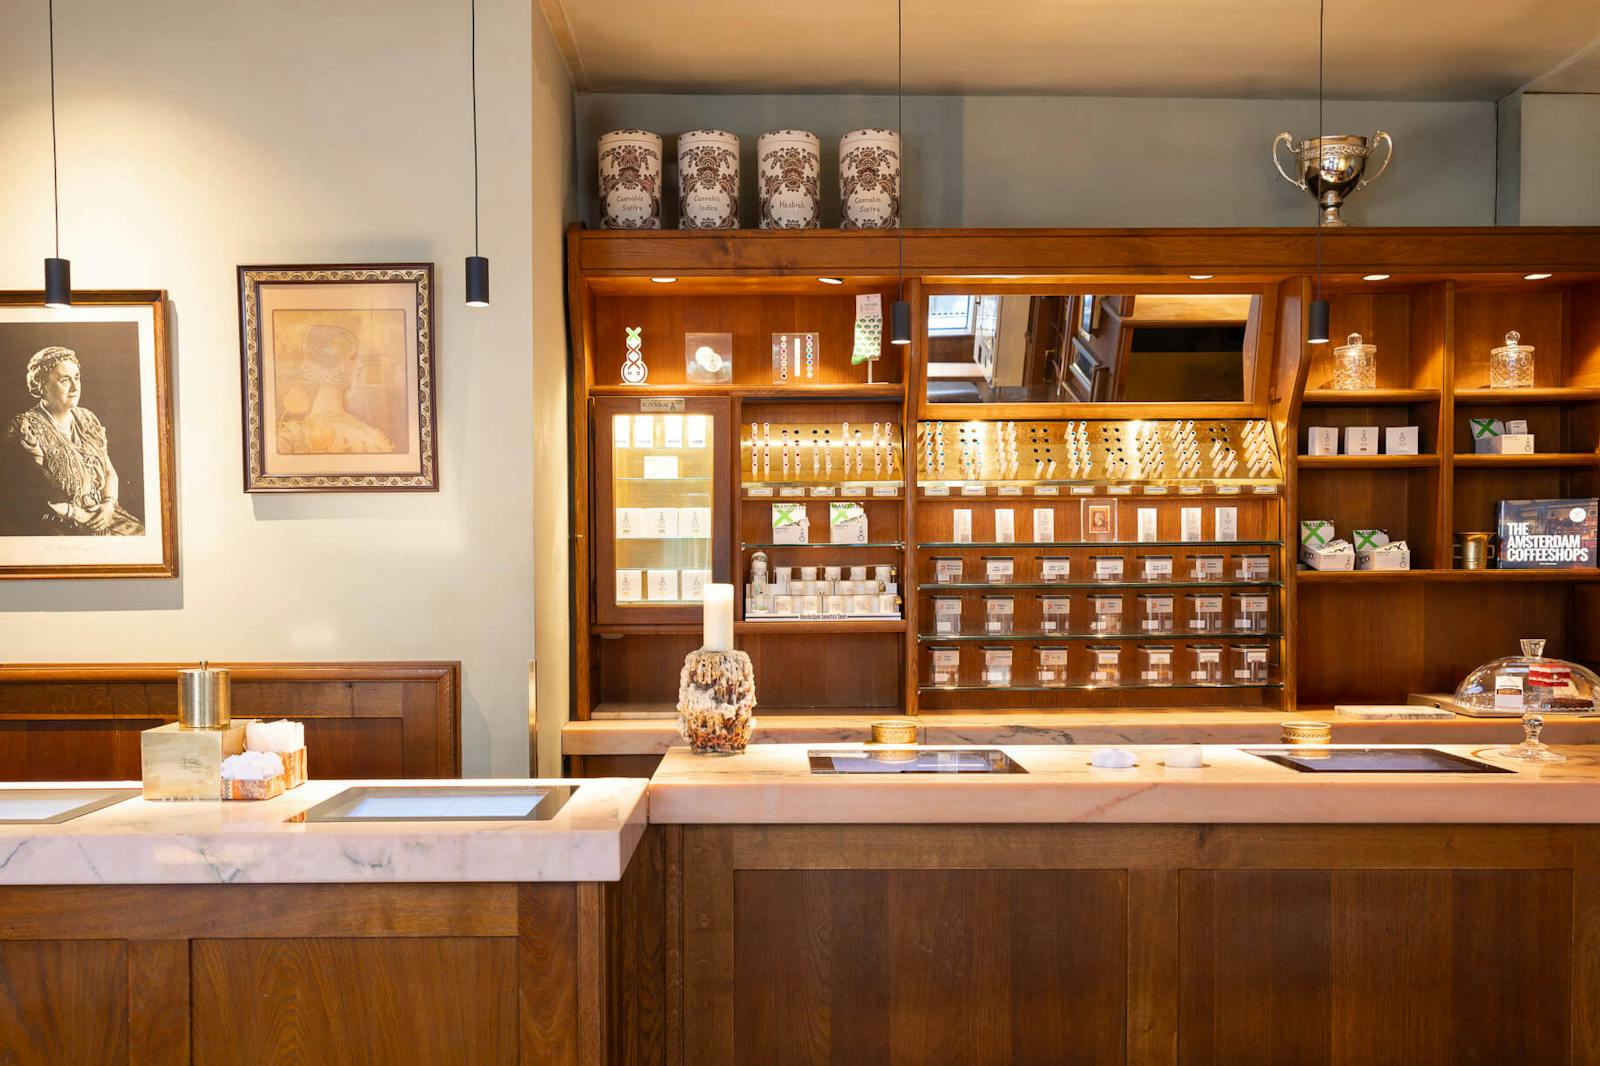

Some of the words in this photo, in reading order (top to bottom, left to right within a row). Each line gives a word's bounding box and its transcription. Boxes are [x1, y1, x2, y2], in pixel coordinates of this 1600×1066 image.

[693, 194, 721, 202] Cannabis
[779, 200, 806, 209] Hashish
[1507, 522, 1530, 536] THE
[1507, 535, 1581, 548] AMSTERDAM
[1507, 548, 1589, 562] COFFEESHOPS
